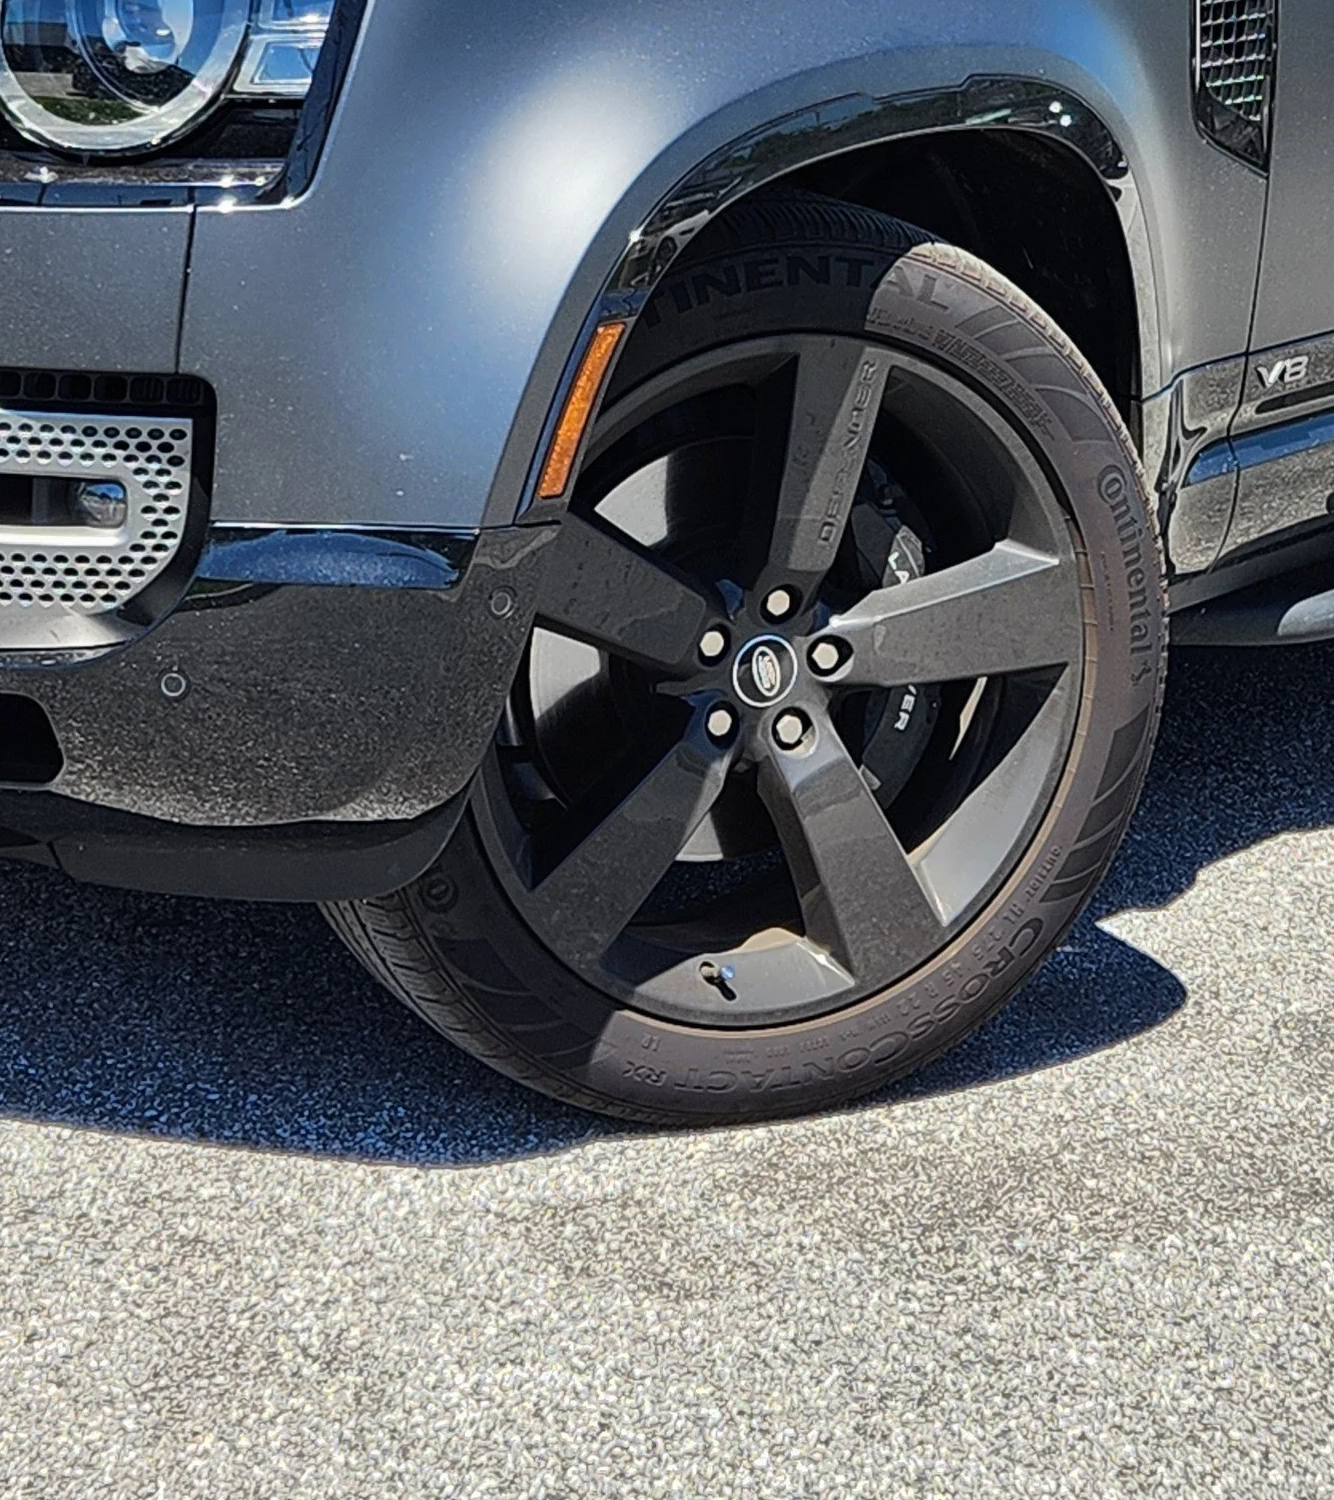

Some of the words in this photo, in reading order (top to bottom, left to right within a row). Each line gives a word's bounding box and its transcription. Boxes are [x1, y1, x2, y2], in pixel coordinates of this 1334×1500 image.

[639, 252, 950, 328] TINENTAL
[1254, 355, 1308, 388] V8
[1097, 463, 1153, 656] Continental
